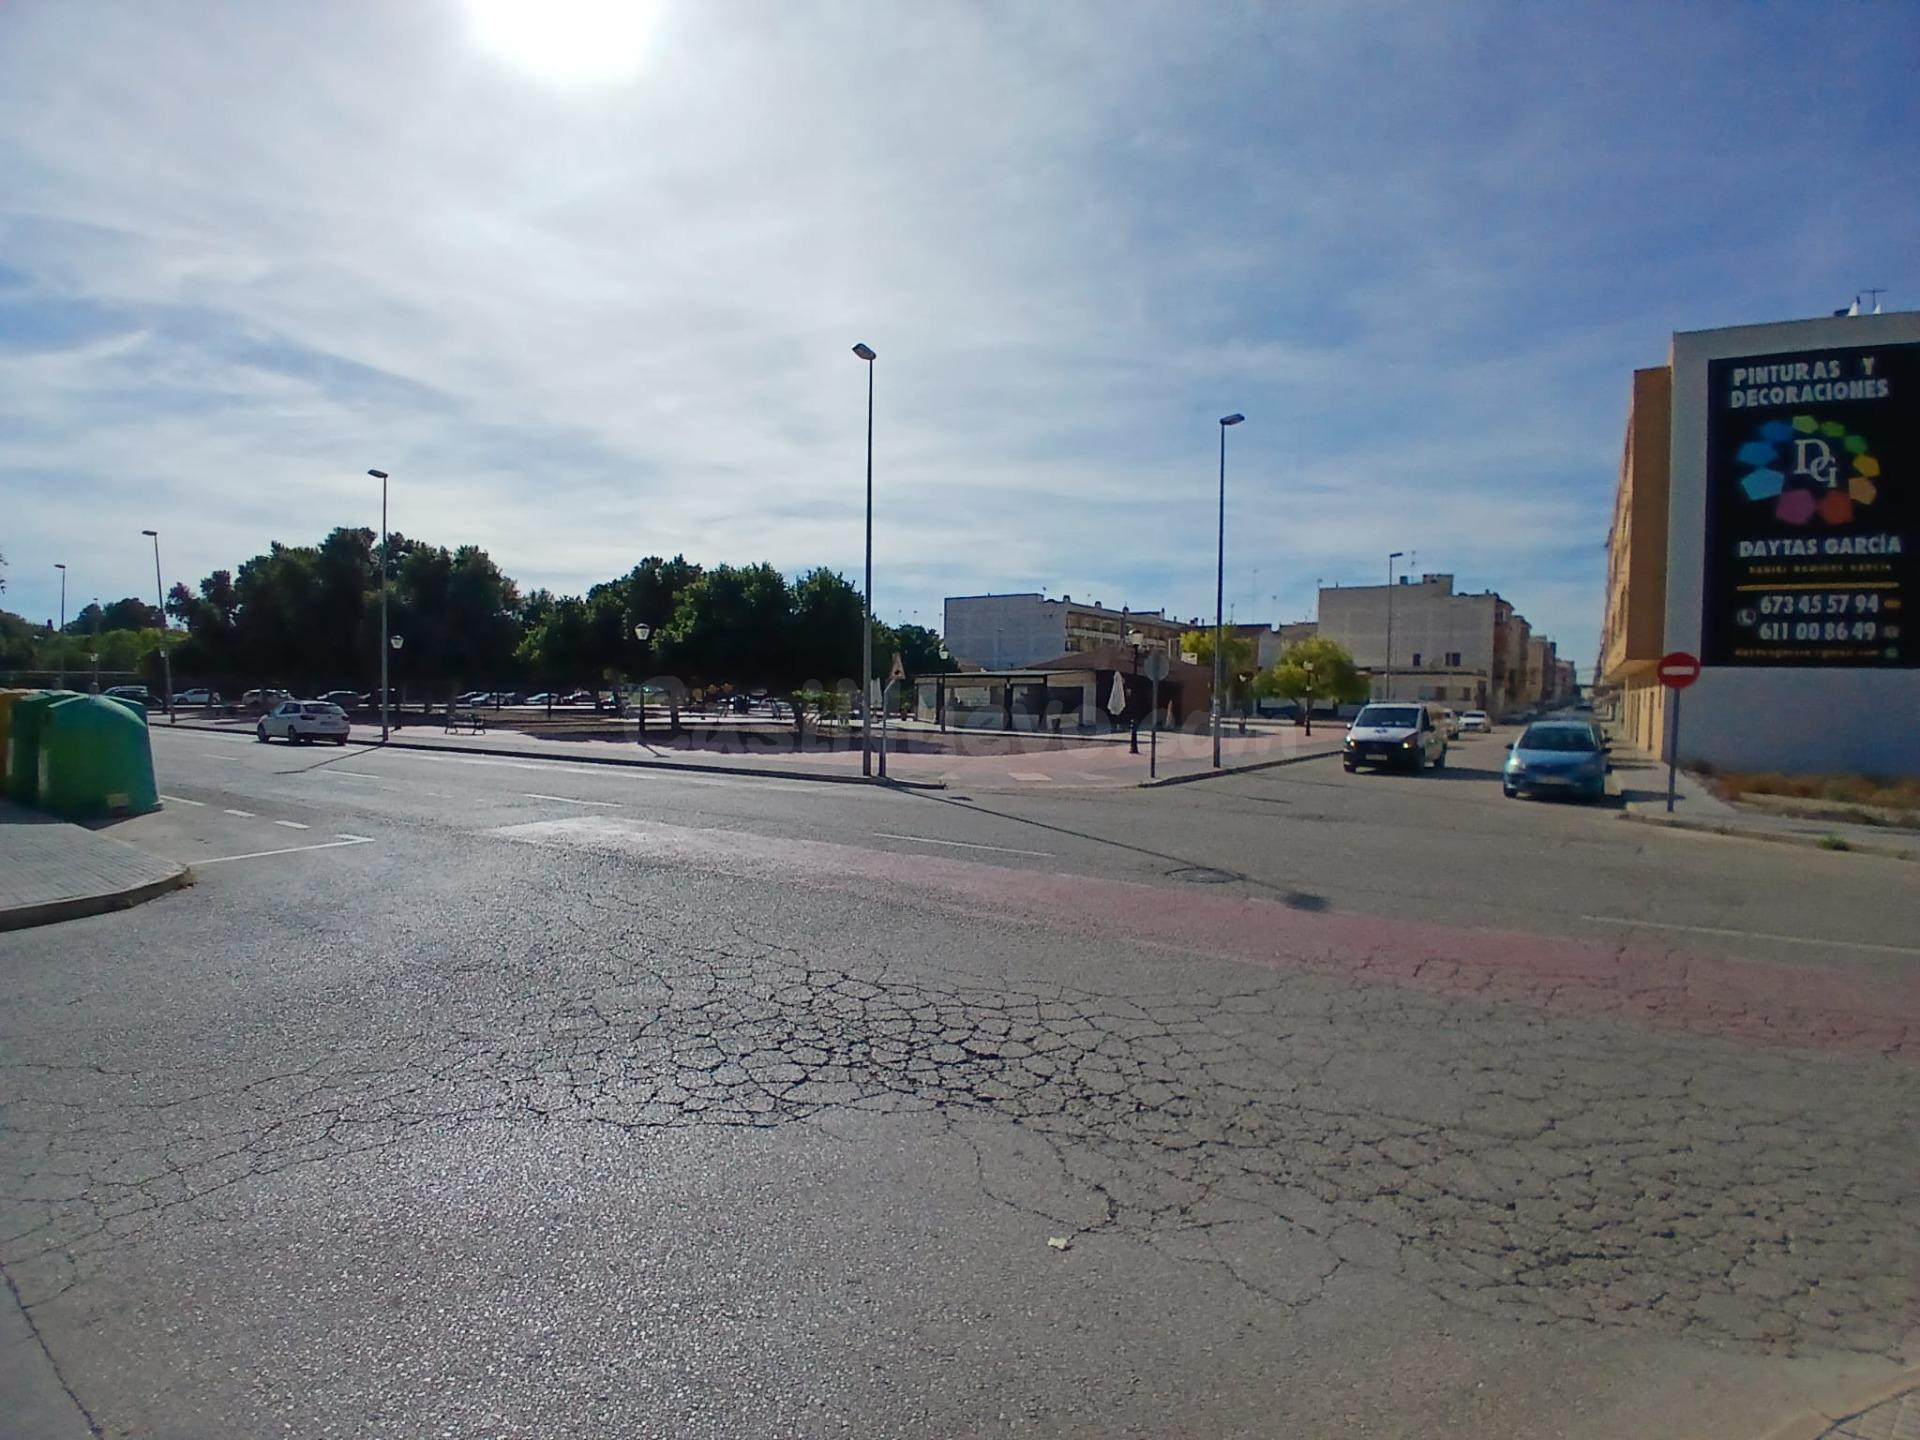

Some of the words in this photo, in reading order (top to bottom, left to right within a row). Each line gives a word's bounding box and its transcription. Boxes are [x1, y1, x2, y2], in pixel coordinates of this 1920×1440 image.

[1733, 360, 1840, 386] PINTURAS
[1862, 357, 1875, 376] Y
[1731, 379, 1889, 408] DECORACIONES
[1739, 538, 1818, 557] DAYTAS
[1825, 533, 1901, 554] GARCÍA
[1760, 595, 1794, 614] 673
[1799, 595, 1822, 614] 45
[1826, 594, 1850, 613] 57
[1855, 594, 1879, 613] 94
[1759, 622, 1789, 640] 611
[1824, 621, 1849, 640] 86
[1851, 621, 1877, 640] 49
